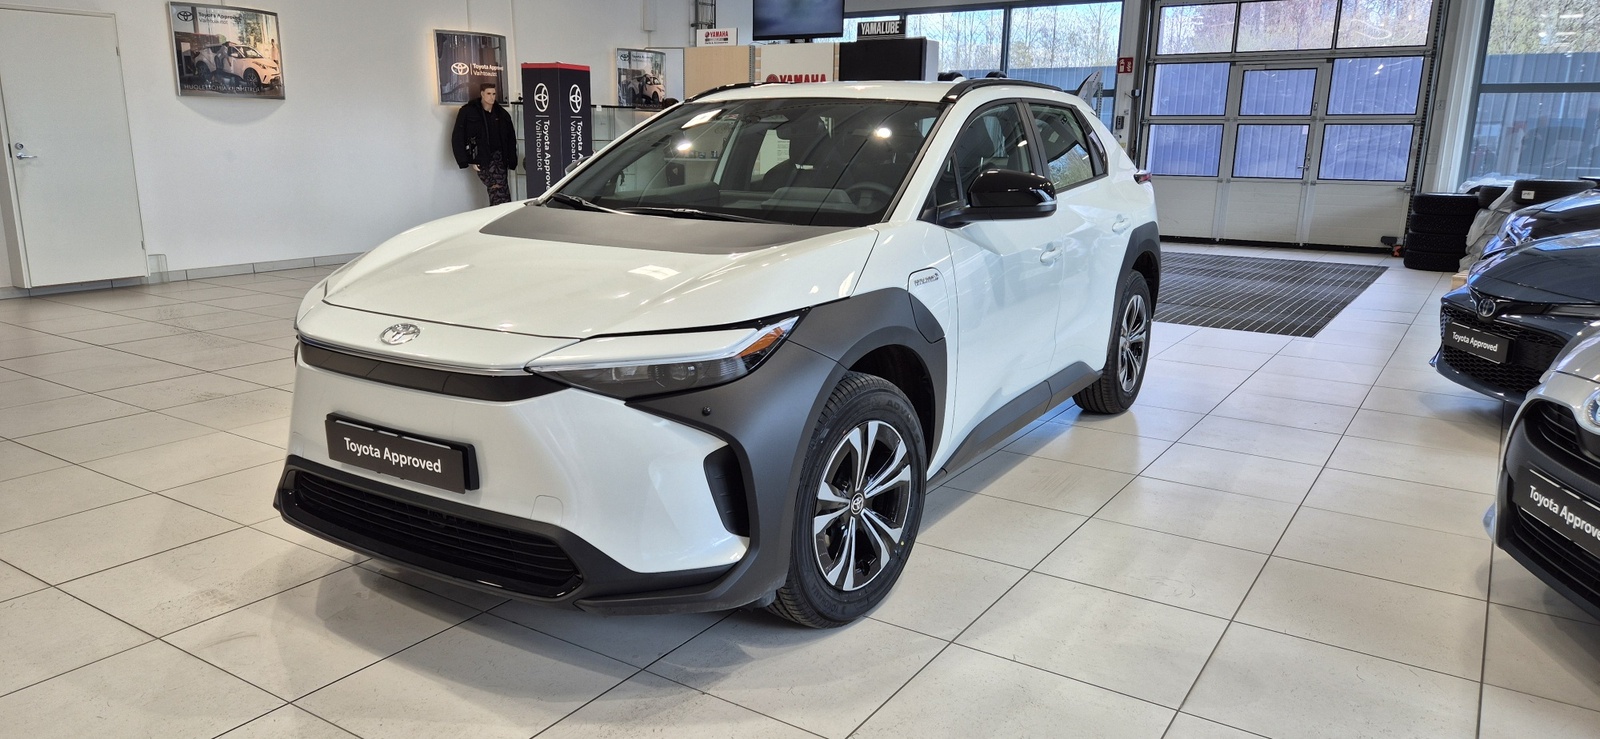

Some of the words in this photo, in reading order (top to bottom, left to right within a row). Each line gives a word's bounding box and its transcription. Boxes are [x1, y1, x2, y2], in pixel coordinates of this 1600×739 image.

[861, 21, 899, 35] YAMALUBE
[779, 74, 826, 83] YAMAHA
[535, 119, 543, 171] Vaihtoautot
[543, 152, 551, 191] Approve
[1452, 331, 1469, 343] Toyota
[1469, 337, 1499, 352] Approved
[343, 436, 381, 458] Toyota
[383, 447, 442, 474] Approved
[1529, 485, 1559, 514] Toyota
[1559, 505, 1600, 541] Approve
